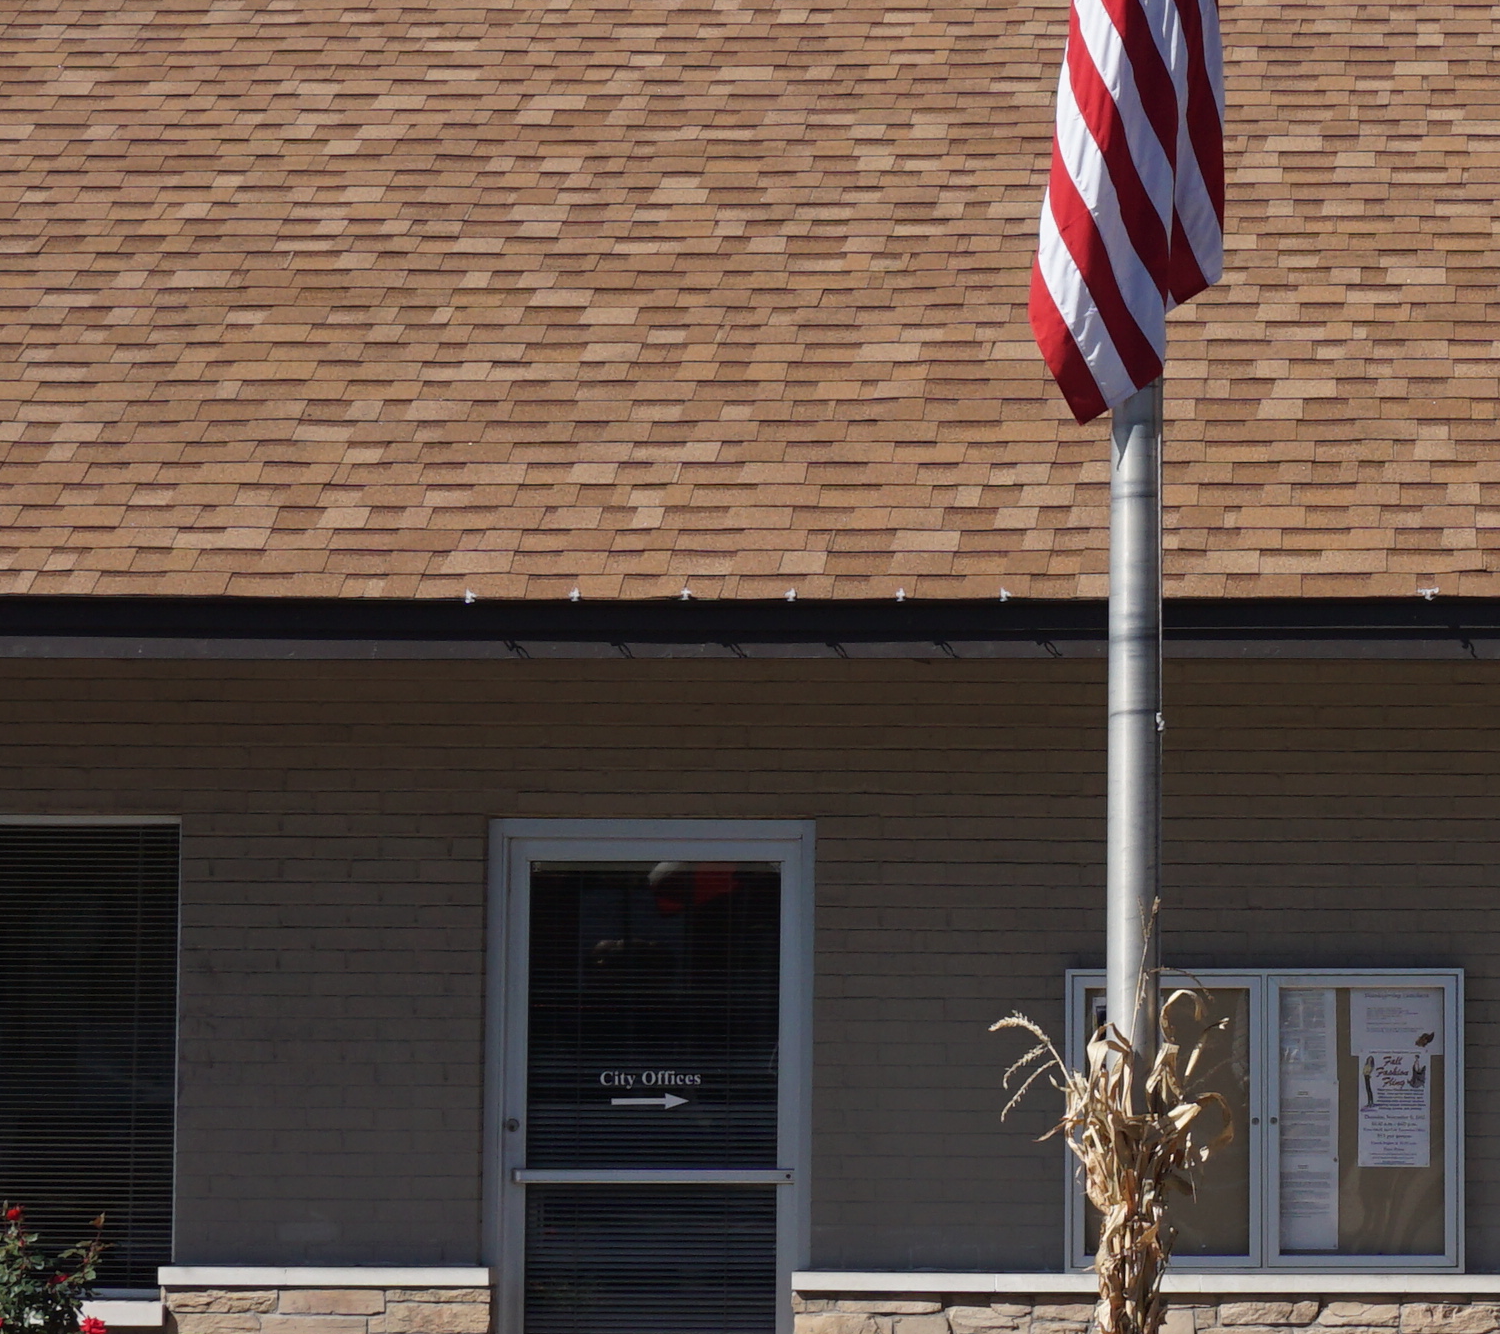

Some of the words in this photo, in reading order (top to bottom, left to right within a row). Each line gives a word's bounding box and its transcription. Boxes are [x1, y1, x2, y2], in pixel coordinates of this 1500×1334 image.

[1383, 1056, 1403, 1067] Fall
[1376, 1067, 1409, 1077] Fashion
[600, 1071, 636, 1089] City
[642, 1070, 701, 1086] Offices
[1382, 1077, 1405, 1089] Fling
